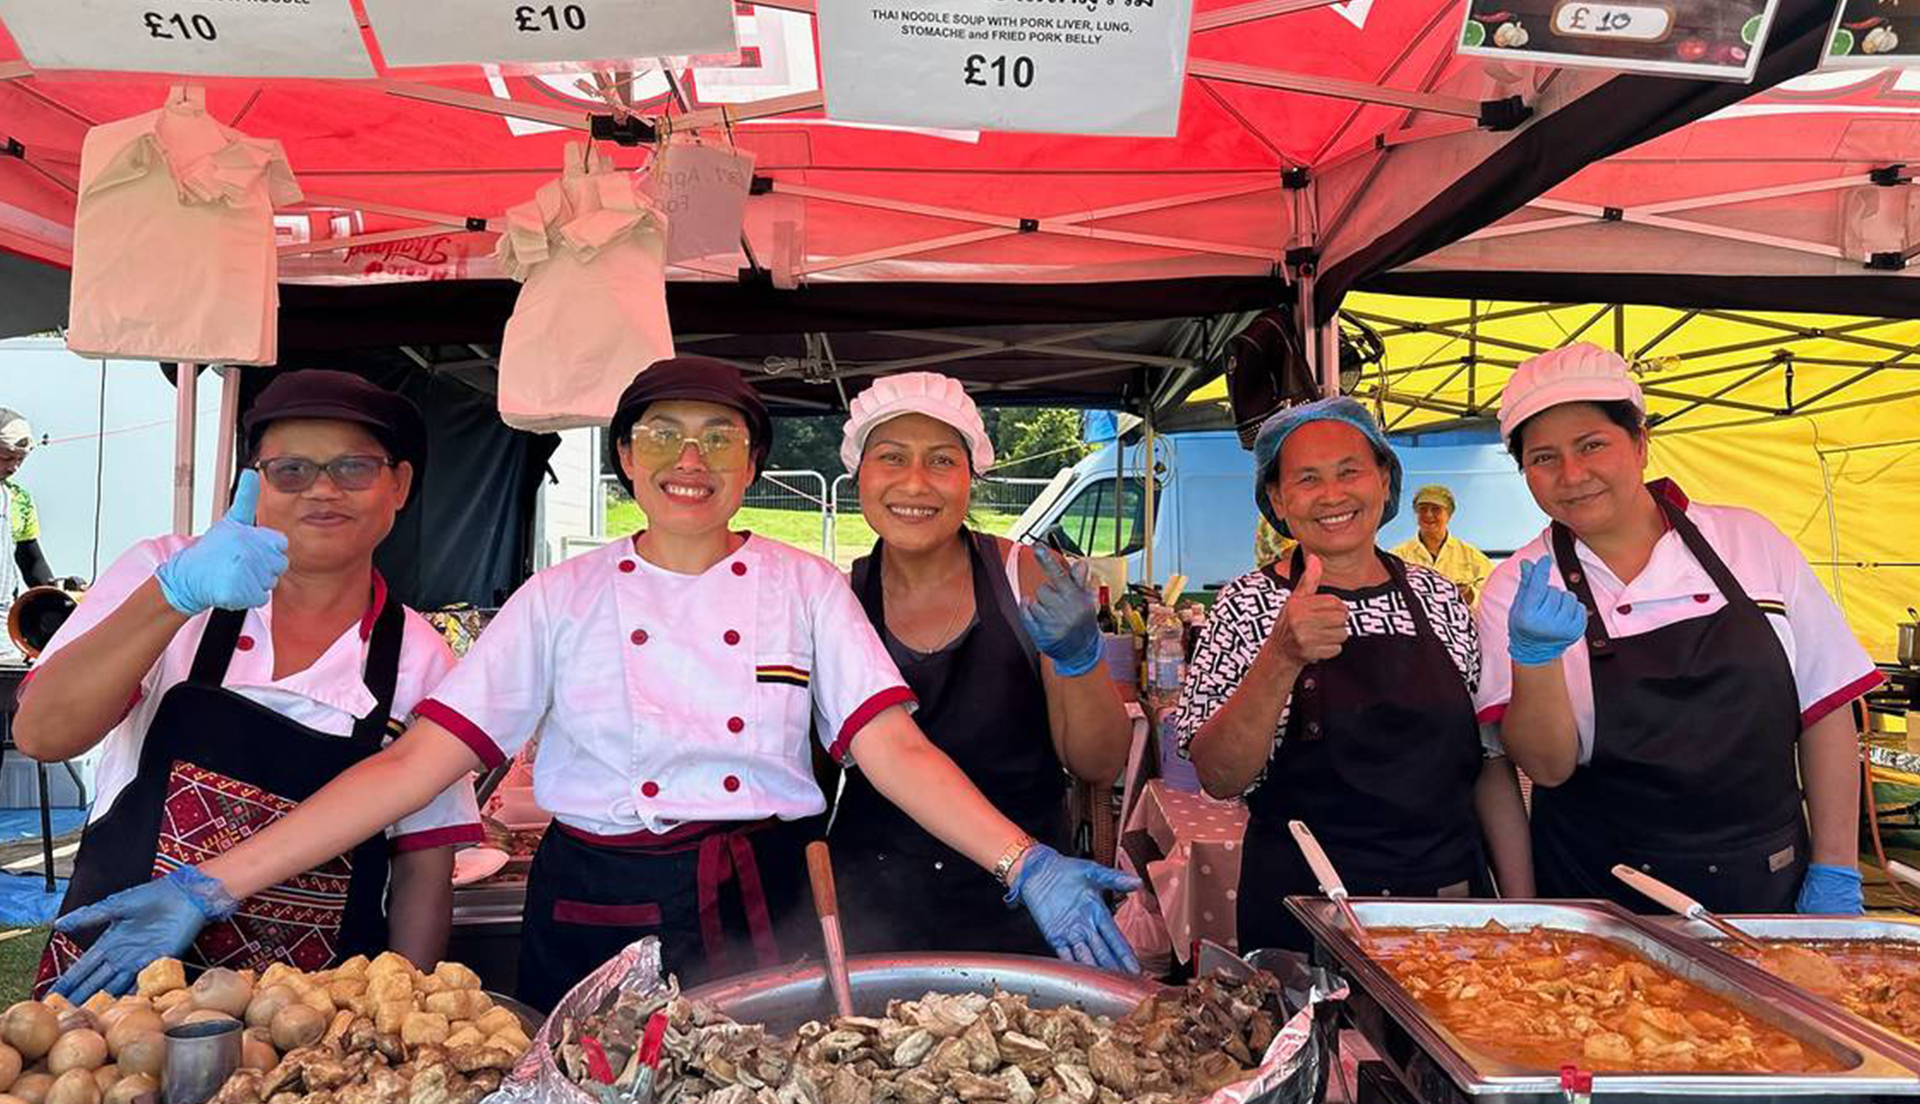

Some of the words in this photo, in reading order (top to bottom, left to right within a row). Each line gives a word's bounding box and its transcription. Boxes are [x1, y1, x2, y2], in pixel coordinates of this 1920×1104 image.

[144, 11, 217, 41] £10
[514, 5, 586, 32] £10
[872, 9, 898, 20] THAI
[901, 10, 951, 23] NOODLE
[953, 13, 985, 25] SOUP
[988, 15, 1018, 27] WITH
[1020, 17, 1054, 29] PORK
[1057, 19, 1093, 31] LIVER,
[1097, 21, 1133, 33] LUNG,
[901, 24, 965, 39] STOMACHE
[968, 29, 989, 40] and
[992, 30, 1026, 42] FRIED
[1029, 31, 1062, 43] PORK
[1065, 33, 1102, 45] BELLY
[964, 54, 1034, 87] £10
